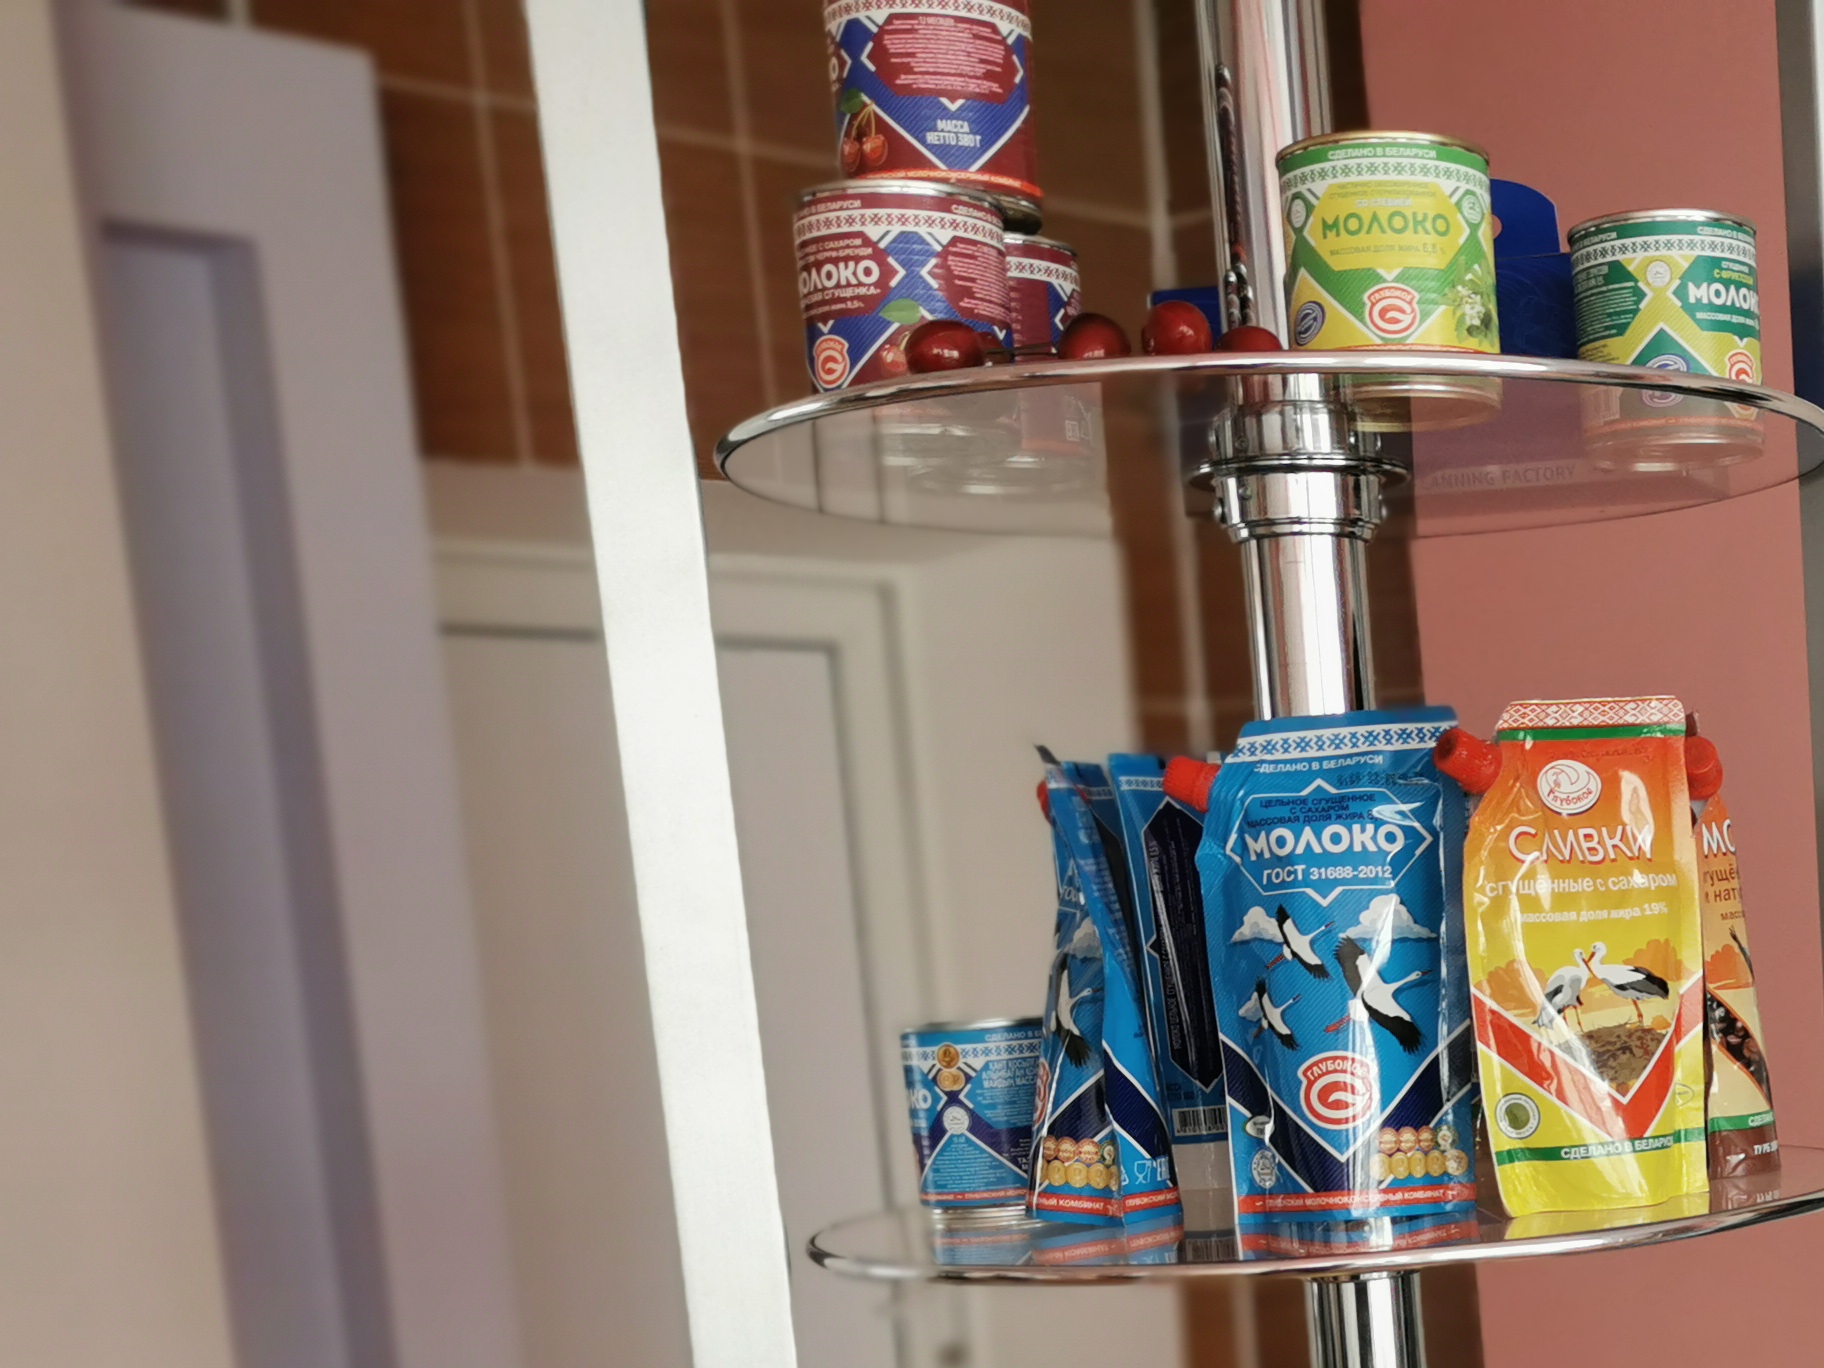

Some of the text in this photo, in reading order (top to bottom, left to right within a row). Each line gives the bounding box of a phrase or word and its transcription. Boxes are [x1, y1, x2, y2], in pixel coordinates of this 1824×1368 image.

[937, 119, 970, 132] МАССА
[926, 132, 957, 145] НЕТТО
[1328, 148, 1374, 159] СДЕЛАНО
[1385, 147, 1437, 158] БЕЛАРУСИ
[1321, 210, 1451, 240] МОЛОКО
[798, 259, 880, 294] ОЛОКО
[1370, 289, 1414, 302] ГЛУБОКОЕ
[1688, 281, 1759, 313] МОЛОК
[1431, 465, 1576, 489] ANNING FACTORY
[1253, 762, 1309, 774] СДЕЛАНО
[1322, 755, 1383, 771] БЕЛАРУСИ
[1259, 793, 1376, 809] ЦЕЛЬНОЕ СГУЩЕННОЕ
[1299, 804, 1350, 815] САХАРОМ
[1247, 814, 1301, 828] МАССОВАЯ
[1302, 813, 1332, 825] ДОЛЯ
[1335, 811, 1366, 821] ЖИРА
[1244, 823, 1406, 862] МОЛОКО
[1508, 825, 1654, 866] СЛИВКИ
[1263, 864, 1393, 885] ГОСТ 31688-2012
[1608, 872, 1677, 890] сахаром
[1521, 903, 1668, 923] массовая доля жира 19%
[985, 1031, 1025, 1041] СДЕЛАНО
[1561, 1136, 1674, 1159] СДЕЛАНО В БЕЛАРУСИ
[1058, 1199, 1104, 1210] КОМБИНАТ
